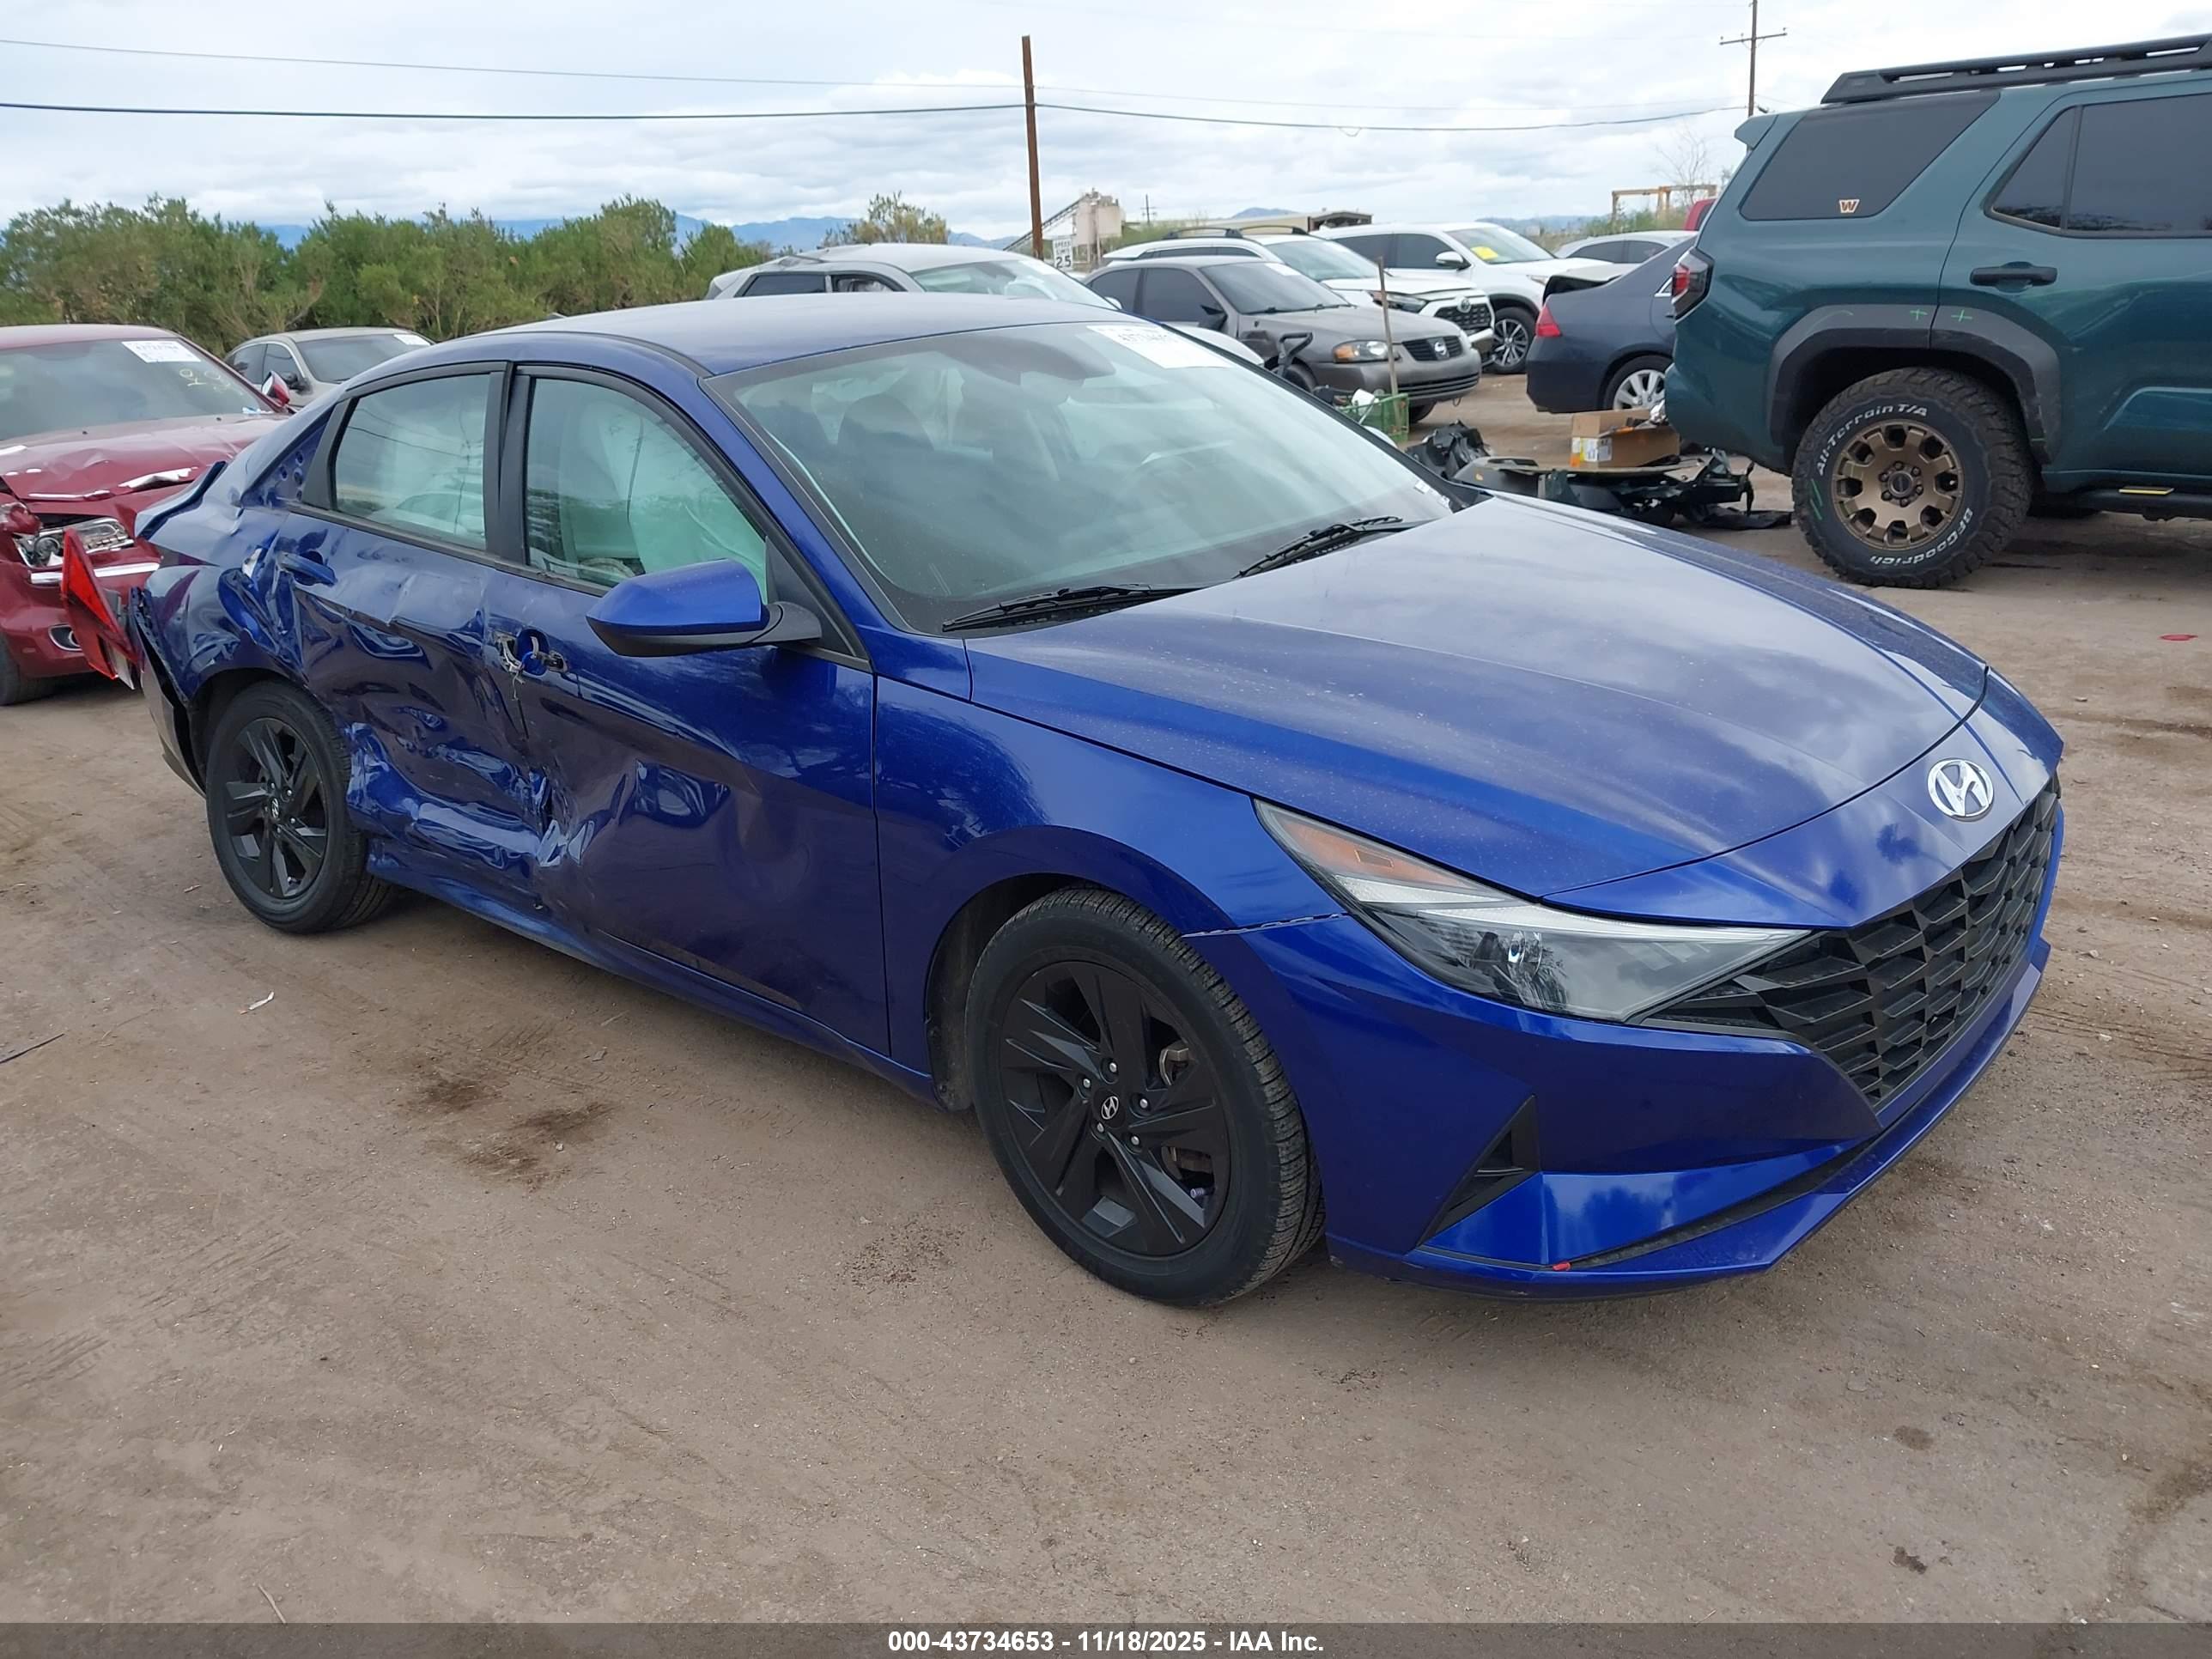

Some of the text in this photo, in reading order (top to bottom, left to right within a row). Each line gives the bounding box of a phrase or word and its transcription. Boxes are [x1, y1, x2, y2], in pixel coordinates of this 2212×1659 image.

[1838, 198, 1860, 214] W
[1055, 255, 1072, 269] 25
[1817, 404, 1928, 476] All-Terrain T/A
[1869, 507, 1973, 566] BFGoodrich
